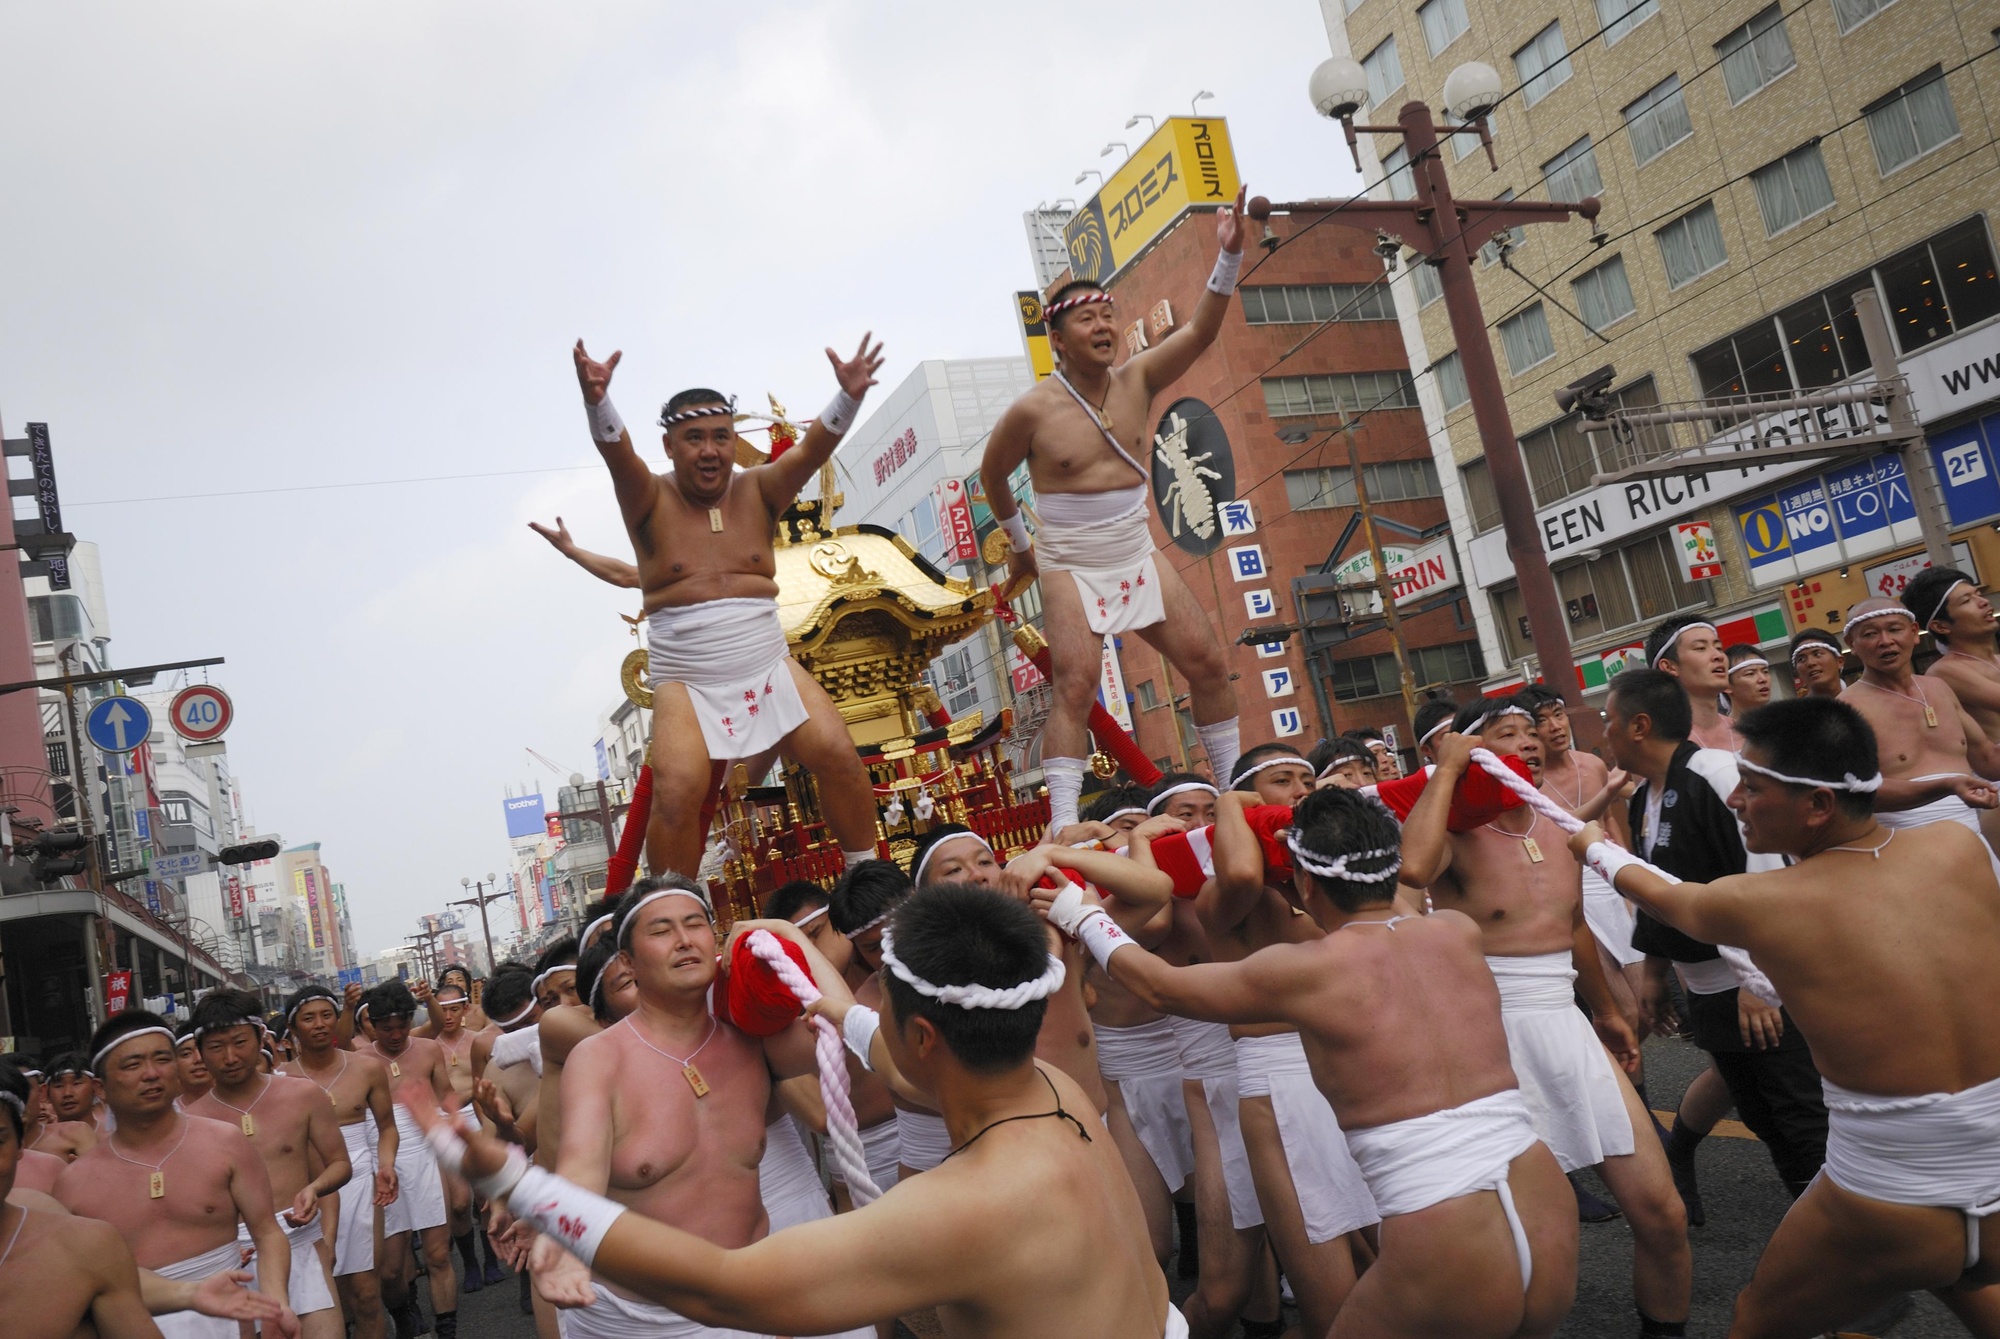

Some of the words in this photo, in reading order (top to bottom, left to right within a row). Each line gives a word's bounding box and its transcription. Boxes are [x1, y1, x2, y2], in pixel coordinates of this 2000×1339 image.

[1190, 123, 1223, 197] プロミス
[1108, 151, 1178, 240] プロミス
[1949, 450, 1978, 478] 2F
[32, 424, 58, 534] できたてのおいし
[1624, 471, 1710, 519] RICH
[952, 507, 972, 545] アコム
[1786, 508, 1829, 540] NO
[961, 548, 972, 556] 3F
[187, 701, 217, 724] 40
[508, 799, 538, 810] brother
[155, 854, 201, 870] 文化通り
[160, 869, 179, 877] Bunka
[181, 865, 199, 873] Street
[229, 886, 242, 915] アイフル
